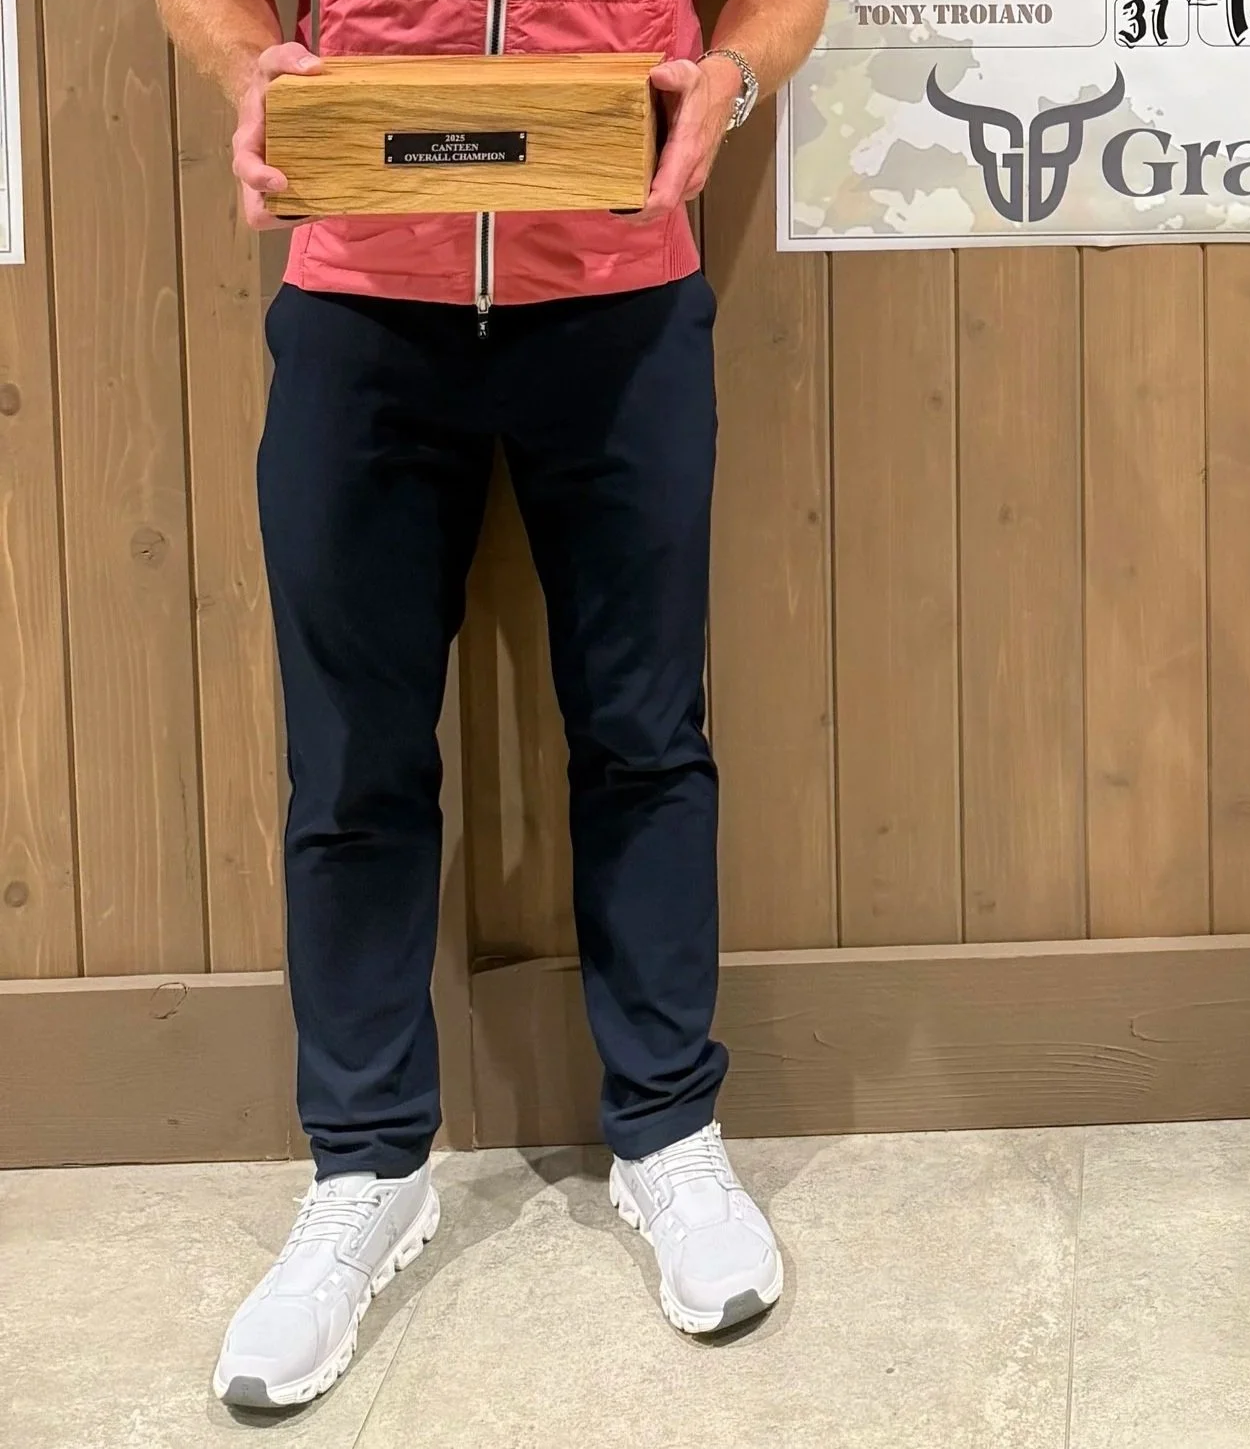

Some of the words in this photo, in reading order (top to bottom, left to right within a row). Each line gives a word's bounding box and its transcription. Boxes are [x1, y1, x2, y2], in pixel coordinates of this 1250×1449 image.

[855, 4, 926, 26] TONY
[933, 3, 1053, 25] TROIANO
[445, 134, 465, 142] 2025
[431, 143, 479, 152] CANTEEN
[404, 153, 451, 162] OVERALL
[452, 152, 505, 161] CHAMPION
